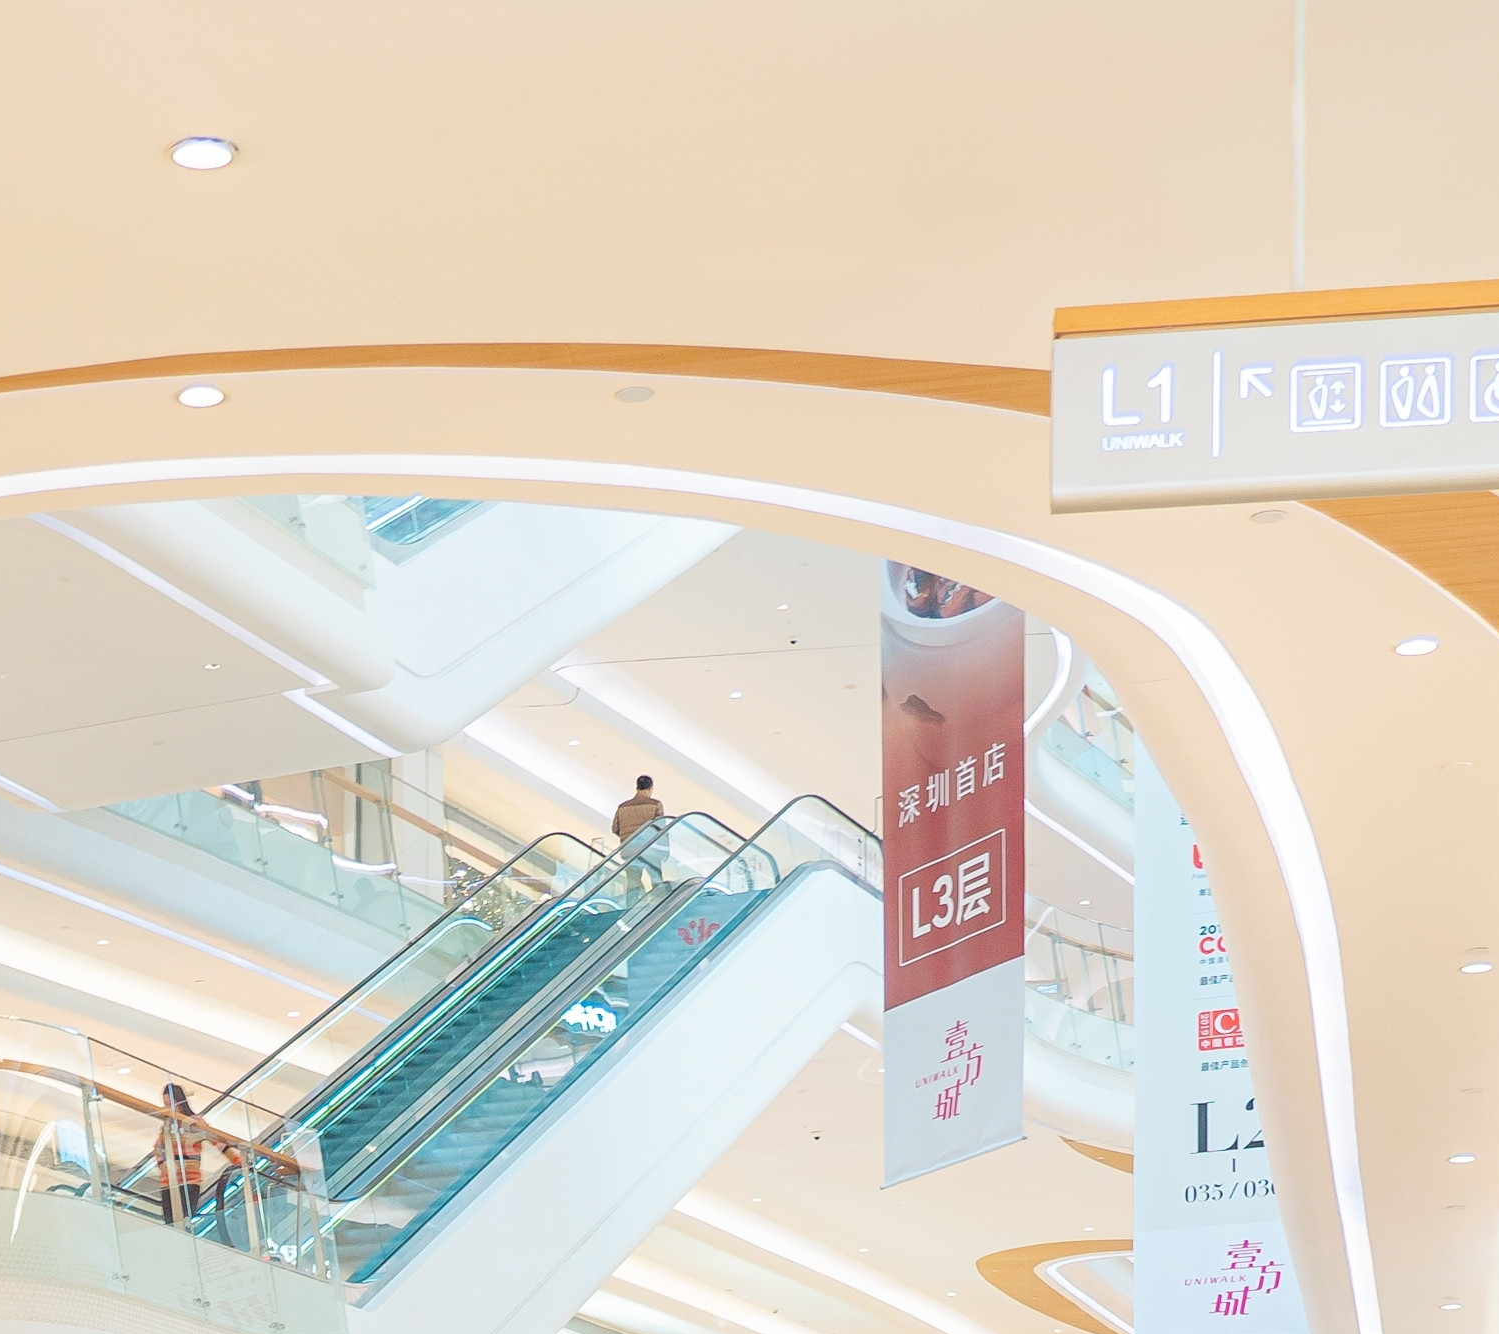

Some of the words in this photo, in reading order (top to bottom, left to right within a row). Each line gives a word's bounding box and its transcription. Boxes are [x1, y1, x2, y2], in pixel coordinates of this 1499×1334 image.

[1102, 365, 1172, 426] L1
[1102, 432, 1184, 451] UNIWALK
[898, 743, 1006, 828] 深圳首店
[912, 851, 992, 939] L3层
[915, 1065, 959, 1089] UNIWALK
[1184, 1275, 1247, 1286] UNIWALK
